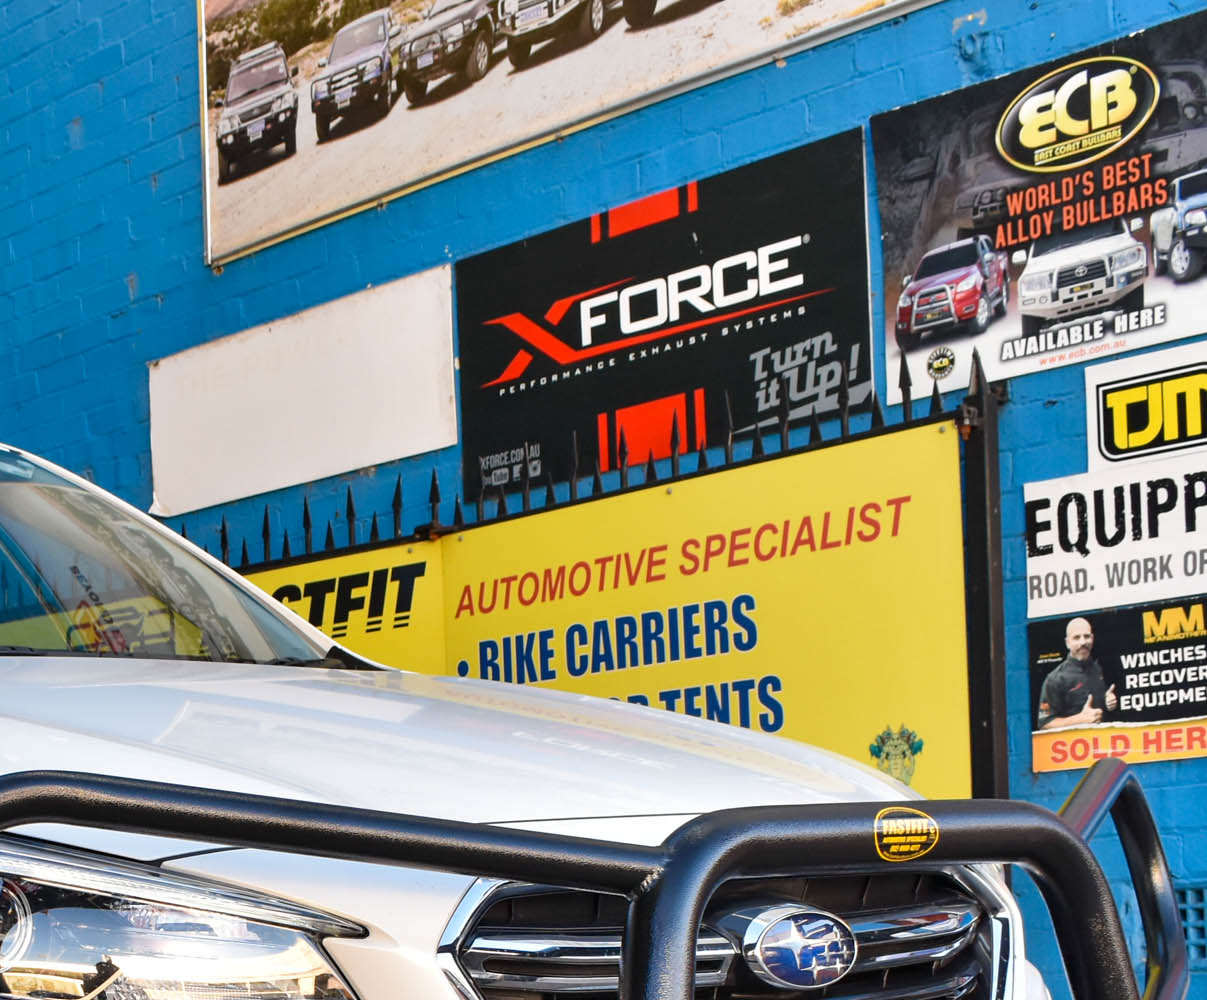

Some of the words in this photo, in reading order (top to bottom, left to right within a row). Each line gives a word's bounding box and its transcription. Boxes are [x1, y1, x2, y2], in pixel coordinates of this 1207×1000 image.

[1019, 68, 1137, 148] ECB
[1034, 149, 1055, 162] EAST
[1055, 141, 1081, 156] COAST
[1081, 128, 1122, 149] BULLBARS
[1006, 170, 1095, 217] WORLD'S
[1102, 153, 1153, 191] BEST
[995, 211, 1054, 249] ALLOY
[1062, 179, 1168, 231] BULLBARS
[480, 234, 806, 388] XFORCE
[1001, 321, 1104, 361] AVAILABLE
[1114, 304, 1167, 333] HERE
[499, 357, 617, 397] PERFORMANCE
[628, 332, 709, 361] EXHAUST
[721, 305, 807, 336] SYSTEMS
[749, 331, 838, 382] Turn
[1038, 338, 1127, 367] www.ecb.com.au
[755, 377, 781, 412] it
[454, 545, 668, 620] AUTOMOTIVE
[678, 496, 911, 577] SPECIALIST
[1029, 568, 1095, 600] ROAD.
[1106, 554, 1174, 589] WORK
[478, 630, 557, 684] BIKE
[565, 594, 758, 678] CARRIERS
[1120, 644, 1207, 669] WINCHES
[659, 675, 783, 733] TENTS
[1120, 687, 1207, 711] EQUIPME
[1051, 734, 1130, 764] SOLD
[1142, 726, 1207, 754] HER
[882, 818, 929, 835] FASTFIT
